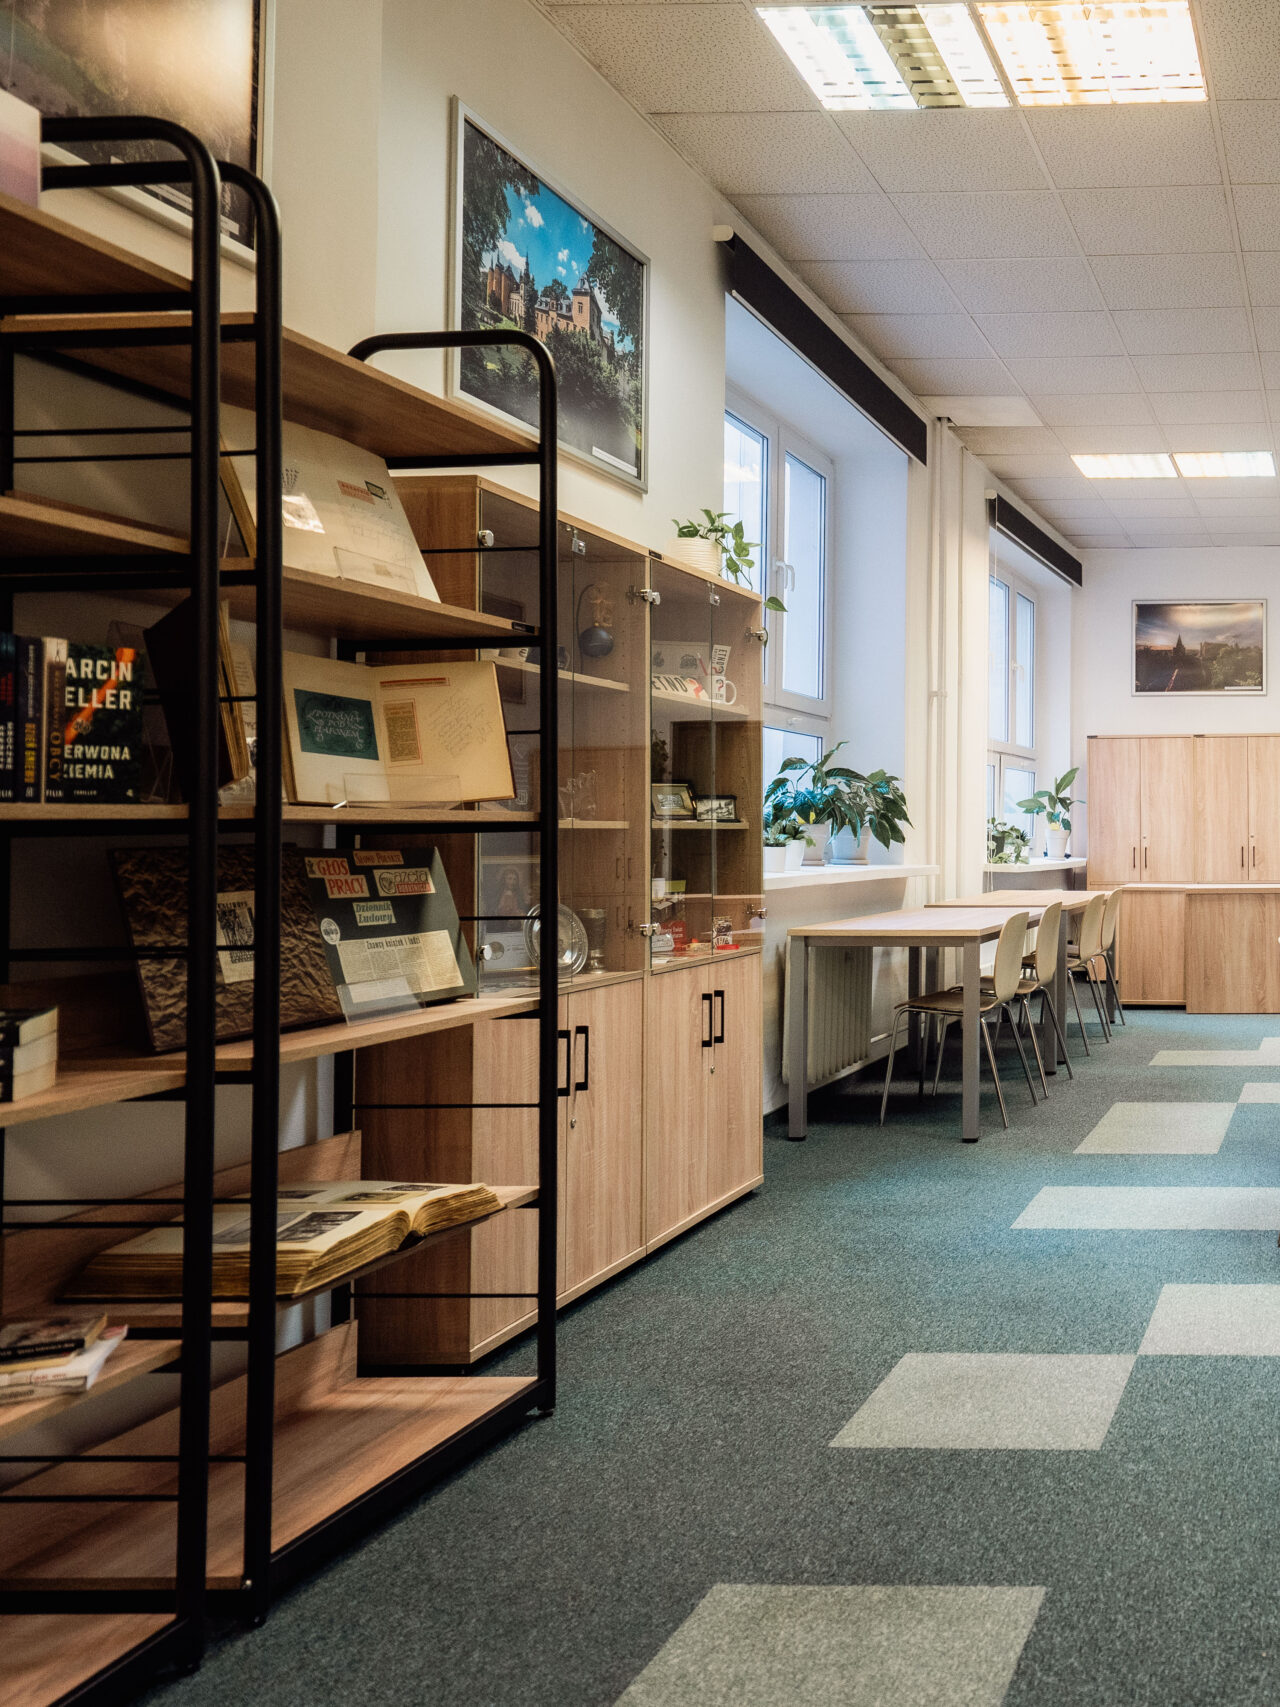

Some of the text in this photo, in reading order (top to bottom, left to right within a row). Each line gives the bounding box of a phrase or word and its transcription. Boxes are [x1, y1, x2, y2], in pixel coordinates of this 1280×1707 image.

[65, 657, 133, 682] ARCIN
[64, 686, 132, 710] ELLER
[63, 744, 131, 760] ERWONA
[317, 858, 348, 876] GŁOS
[327, 877, 365, 896] PRACY
